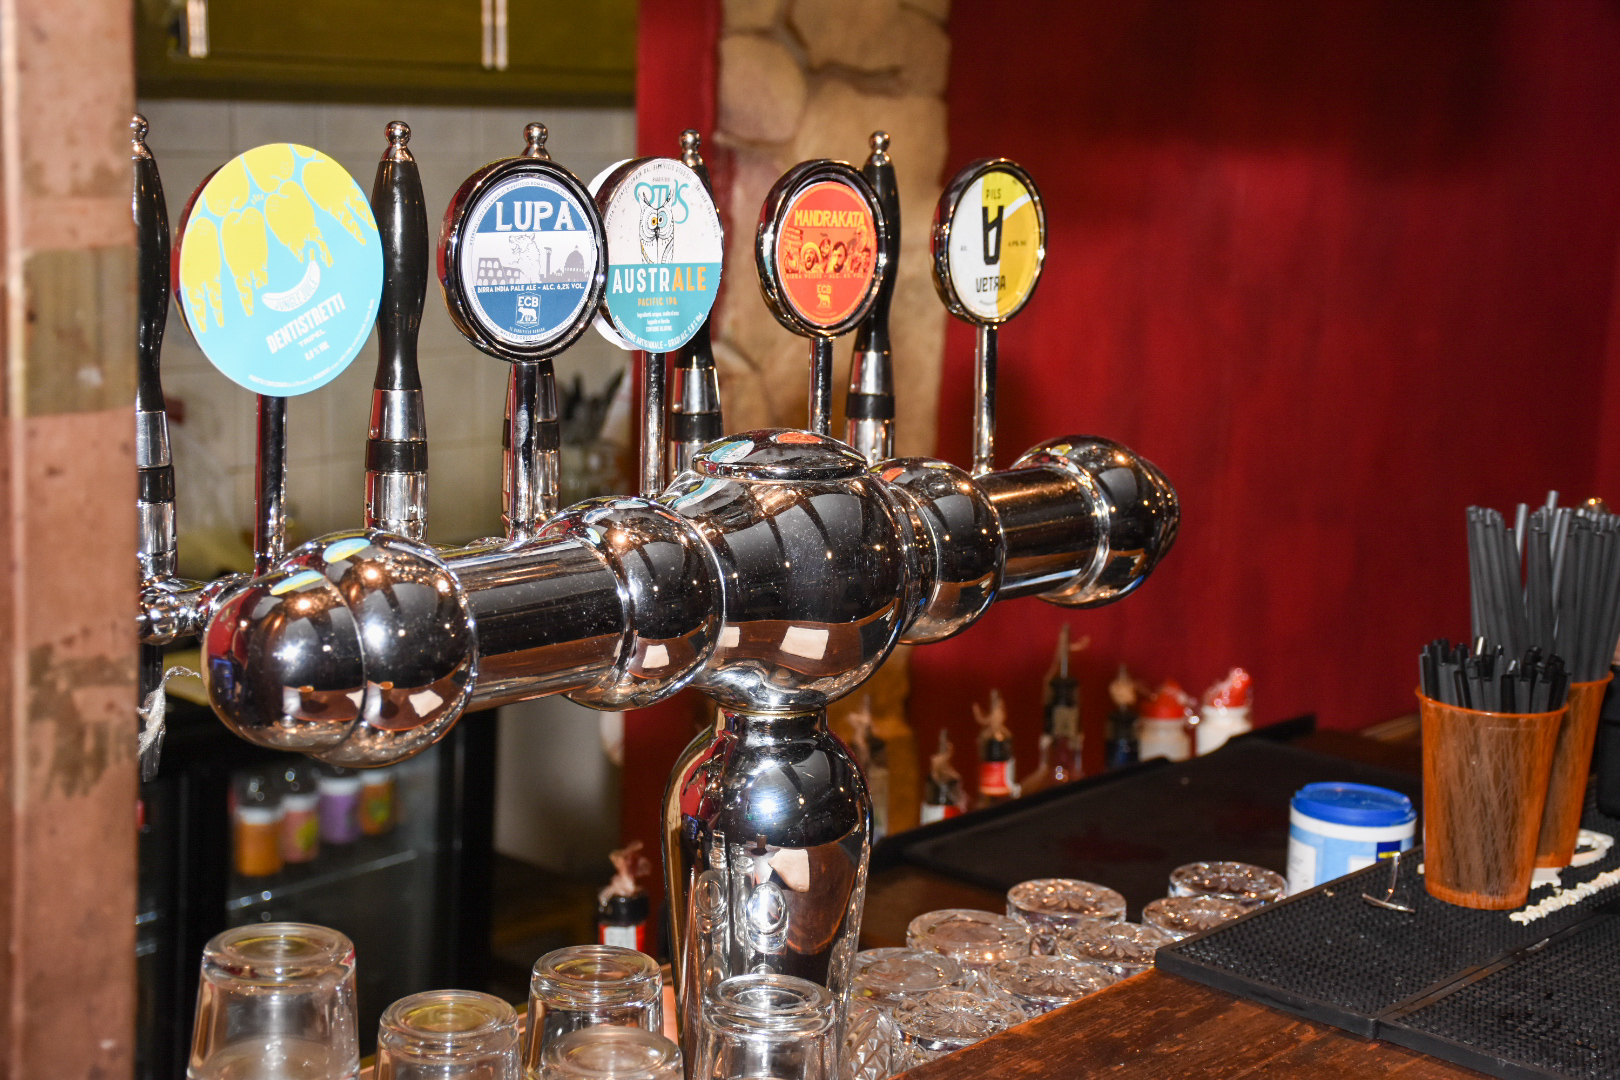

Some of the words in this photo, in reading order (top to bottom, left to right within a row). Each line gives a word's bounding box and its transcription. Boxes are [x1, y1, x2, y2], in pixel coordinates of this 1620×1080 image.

[986, 188, 1002, 200] PILS
[495, 200, 576, 232] LUPA
[794, 210, 866, 228] MANDRAKATA
[478, 286, 494, 294] BIRRA
[495, 285, 510, 293] INDIA
[510, 284, 525, 292] PALE
[542, 283, 556, 291] ALC.
[612, 266, 707, 294] AUSTRALE
[275, 292, 304, 310] JUNGLE
[301, 275, 318, 300] JUICE
[817, 284, 832, 295] ECB
[517, 296, 539, 308] ECB
[638, 297, 665, 306] PACIFIC
[266, 292, 346, 354] DENTISTRETTI
[298, 329, 326, 348] TRIPEL
